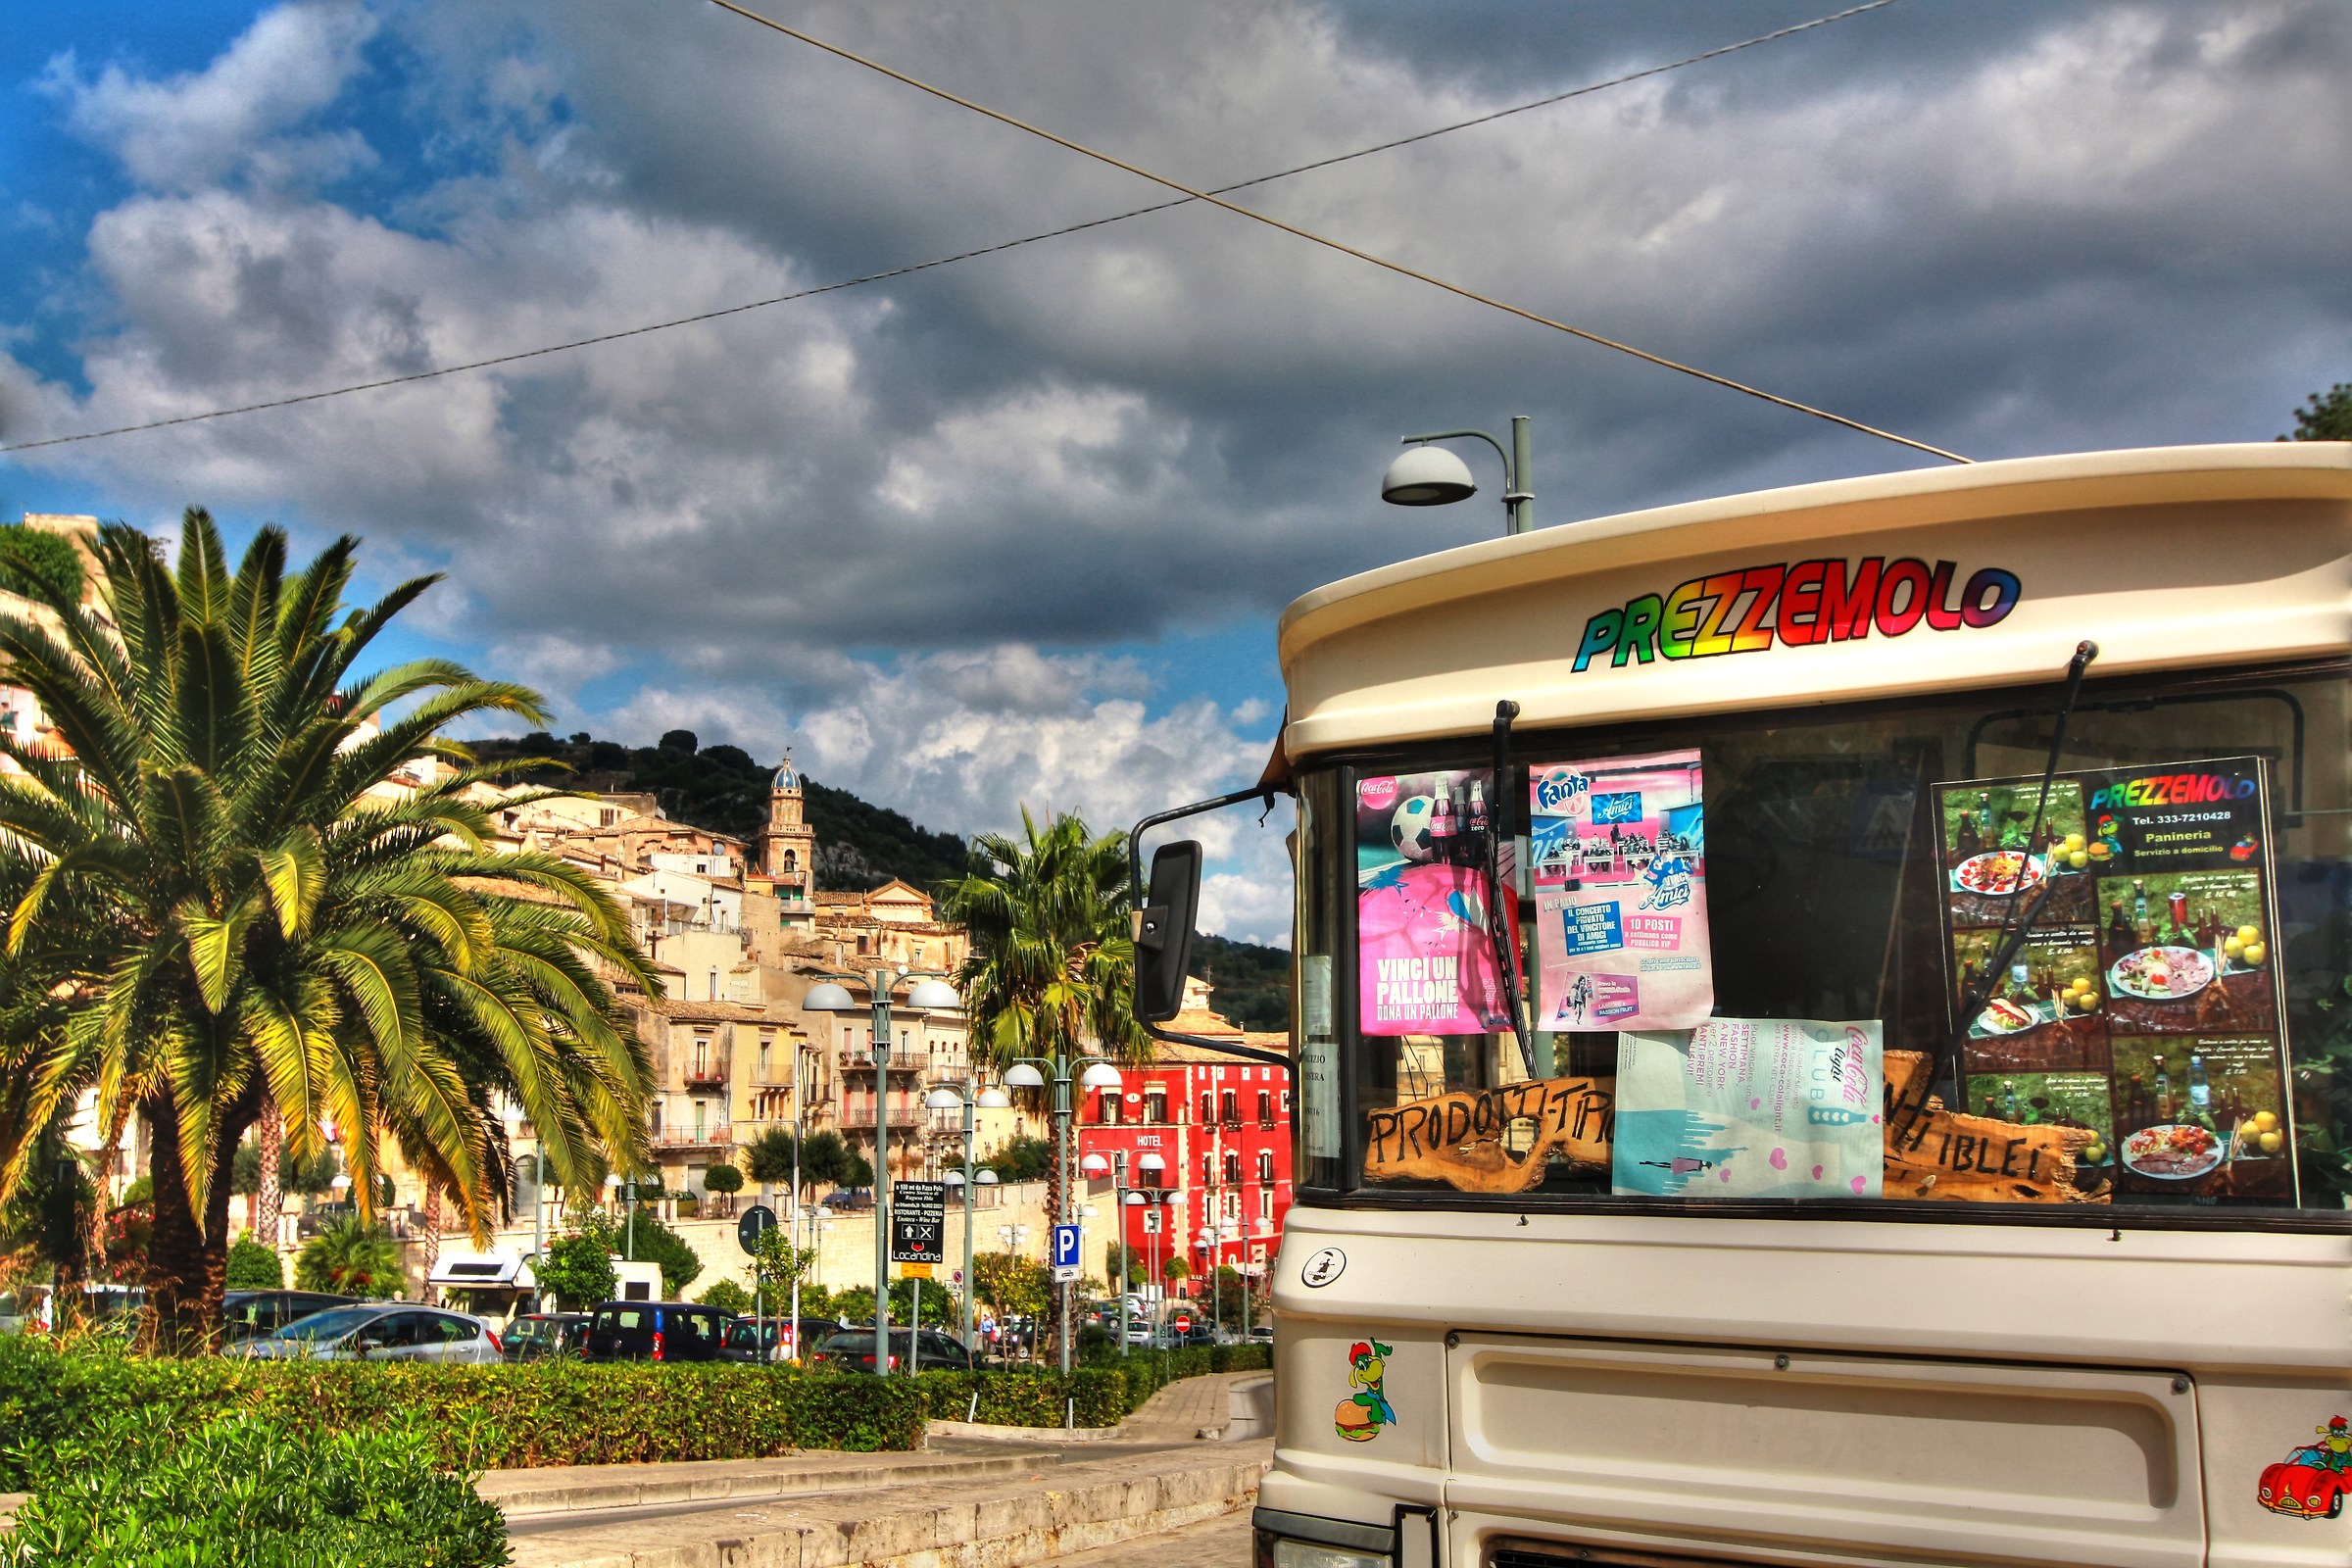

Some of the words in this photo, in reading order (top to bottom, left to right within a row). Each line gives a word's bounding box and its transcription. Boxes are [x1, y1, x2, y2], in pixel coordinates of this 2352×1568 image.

[1570, 557, 2023, 674] PREZZEMOLO
[1537, 775, 1590, 809] Fanta
[2089, 774, 2256, 809] PREZZEMOLO
[1597, 796, 1635, 820] Amici
[2132, 816, 2154, 825] Tel.
[2157, 811, 2231, 824] 333-7210428
[2146, 830, 2212, 843] Panineria
[2134, 849, 2171, 858] Servizio
[2181, 845, 2224, 855] domicilio
[1639, 884, 1690, 911] Amici
[1568, 908, 1574, 917] IL
[1576, 905, 1611, 916] CONCERTO
[1576, 914, 1604, 925] PRIVATO
[1567, 925, 1579, 935] DEL
[1581, 921, 1616, 933] VINCITORE
[1587, 931, 1606, 941] AMICI
[1630, 919, 1641, 930] 10
[1644, 918, 1674, 931] POSTI
[1377, 957, 1429, 981] VINCI
[1433, 956, 1457, 980] UN
[1377, 980, 1458, 1004] PALLONE
[1377, 1004, 1401, 1021] DONA
[1404, 1004, 1417, 1020] UN
[1421, 1004, 1458, 1020] PALLONE
[1707, 1022, 1717, 1038] per
[1719, 1034, 1728, 1058] NEW
[1729, 1023, 1740, 1069] FASHION
[1696, 1054, 1706, 1086] PREMI
[1706, 1050, 1715, 1088] persone
[1717, 1062, 1726, 1090] YORK
[1747, 1049, 1756, 1082] vincere
[1810, 1029, 1830, 1101] CLUB
[1830, 1048, 1845, 1082] light
[1137, 1135, 1163, 1147] HOTEL
[893, 1250, 941, 1261] Locandina
[1059, 1229, 1075, 1262] P
